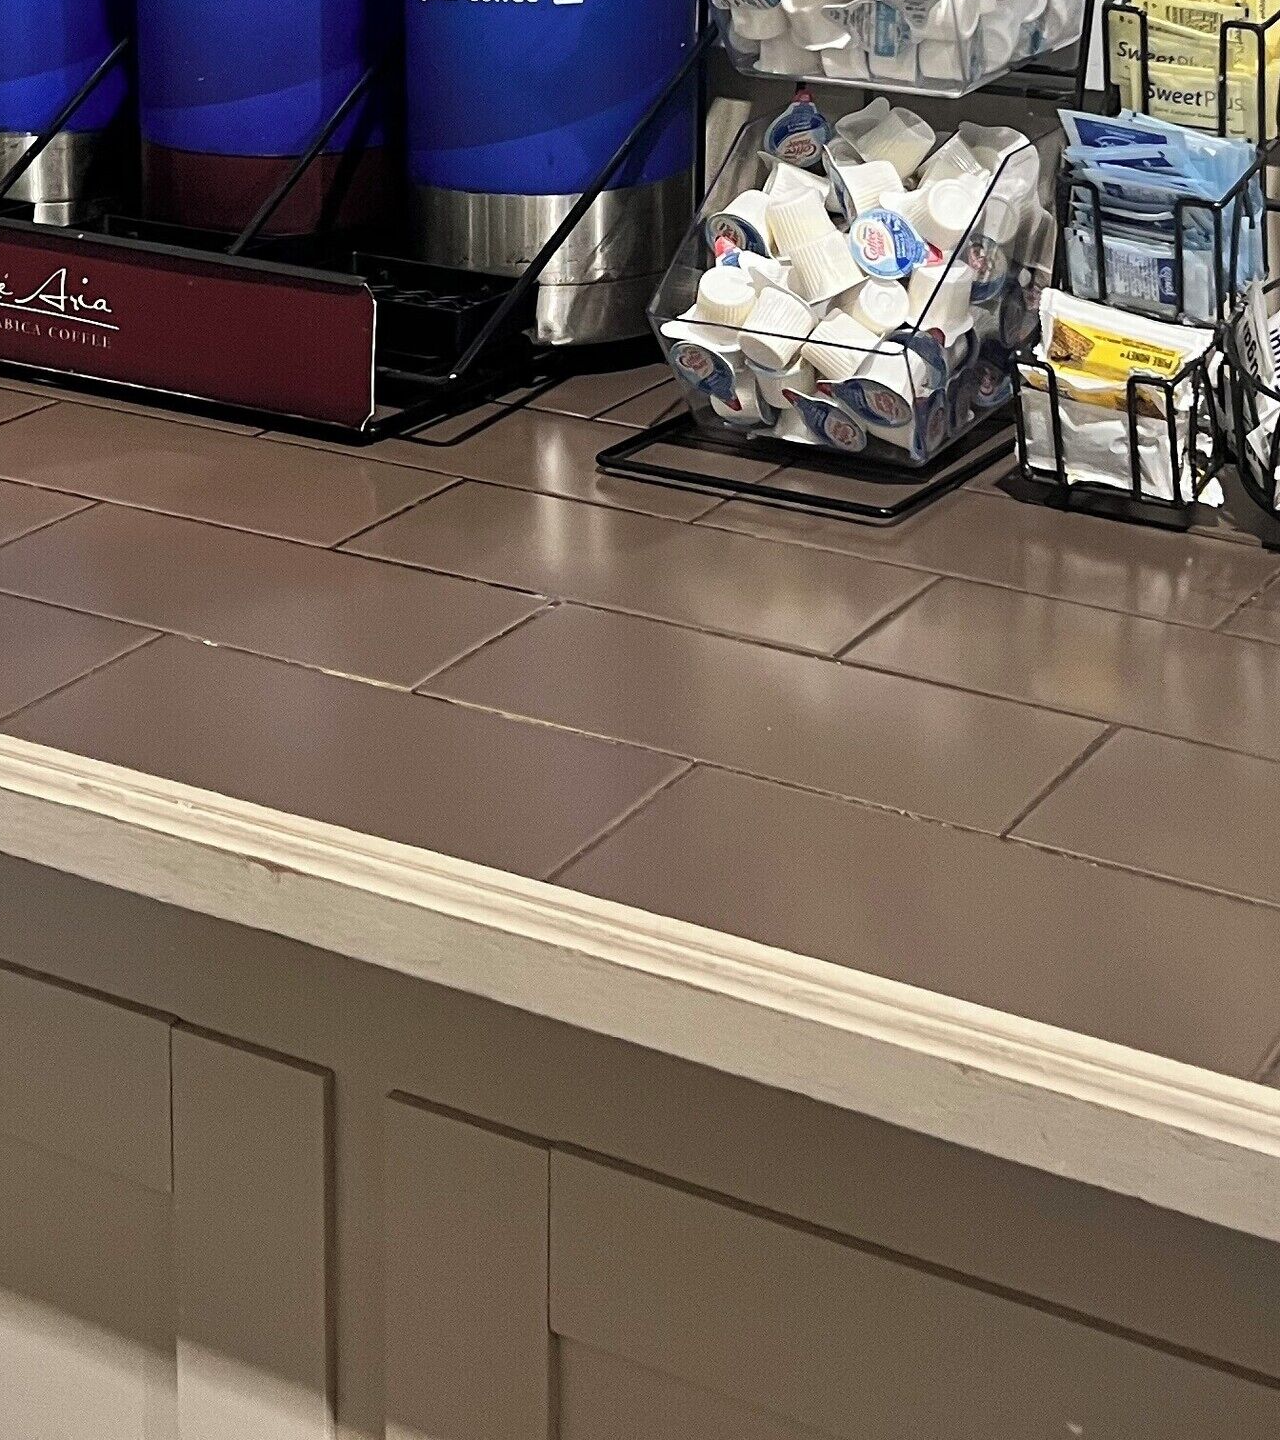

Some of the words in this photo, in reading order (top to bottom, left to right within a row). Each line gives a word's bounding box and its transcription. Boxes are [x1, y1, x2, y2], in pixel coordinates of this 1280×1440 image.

[1146, 81, 1247, 112] SweetPus
[14, 267, 112, 313] Aria
[47, 326, 112, 349] COFFEE
